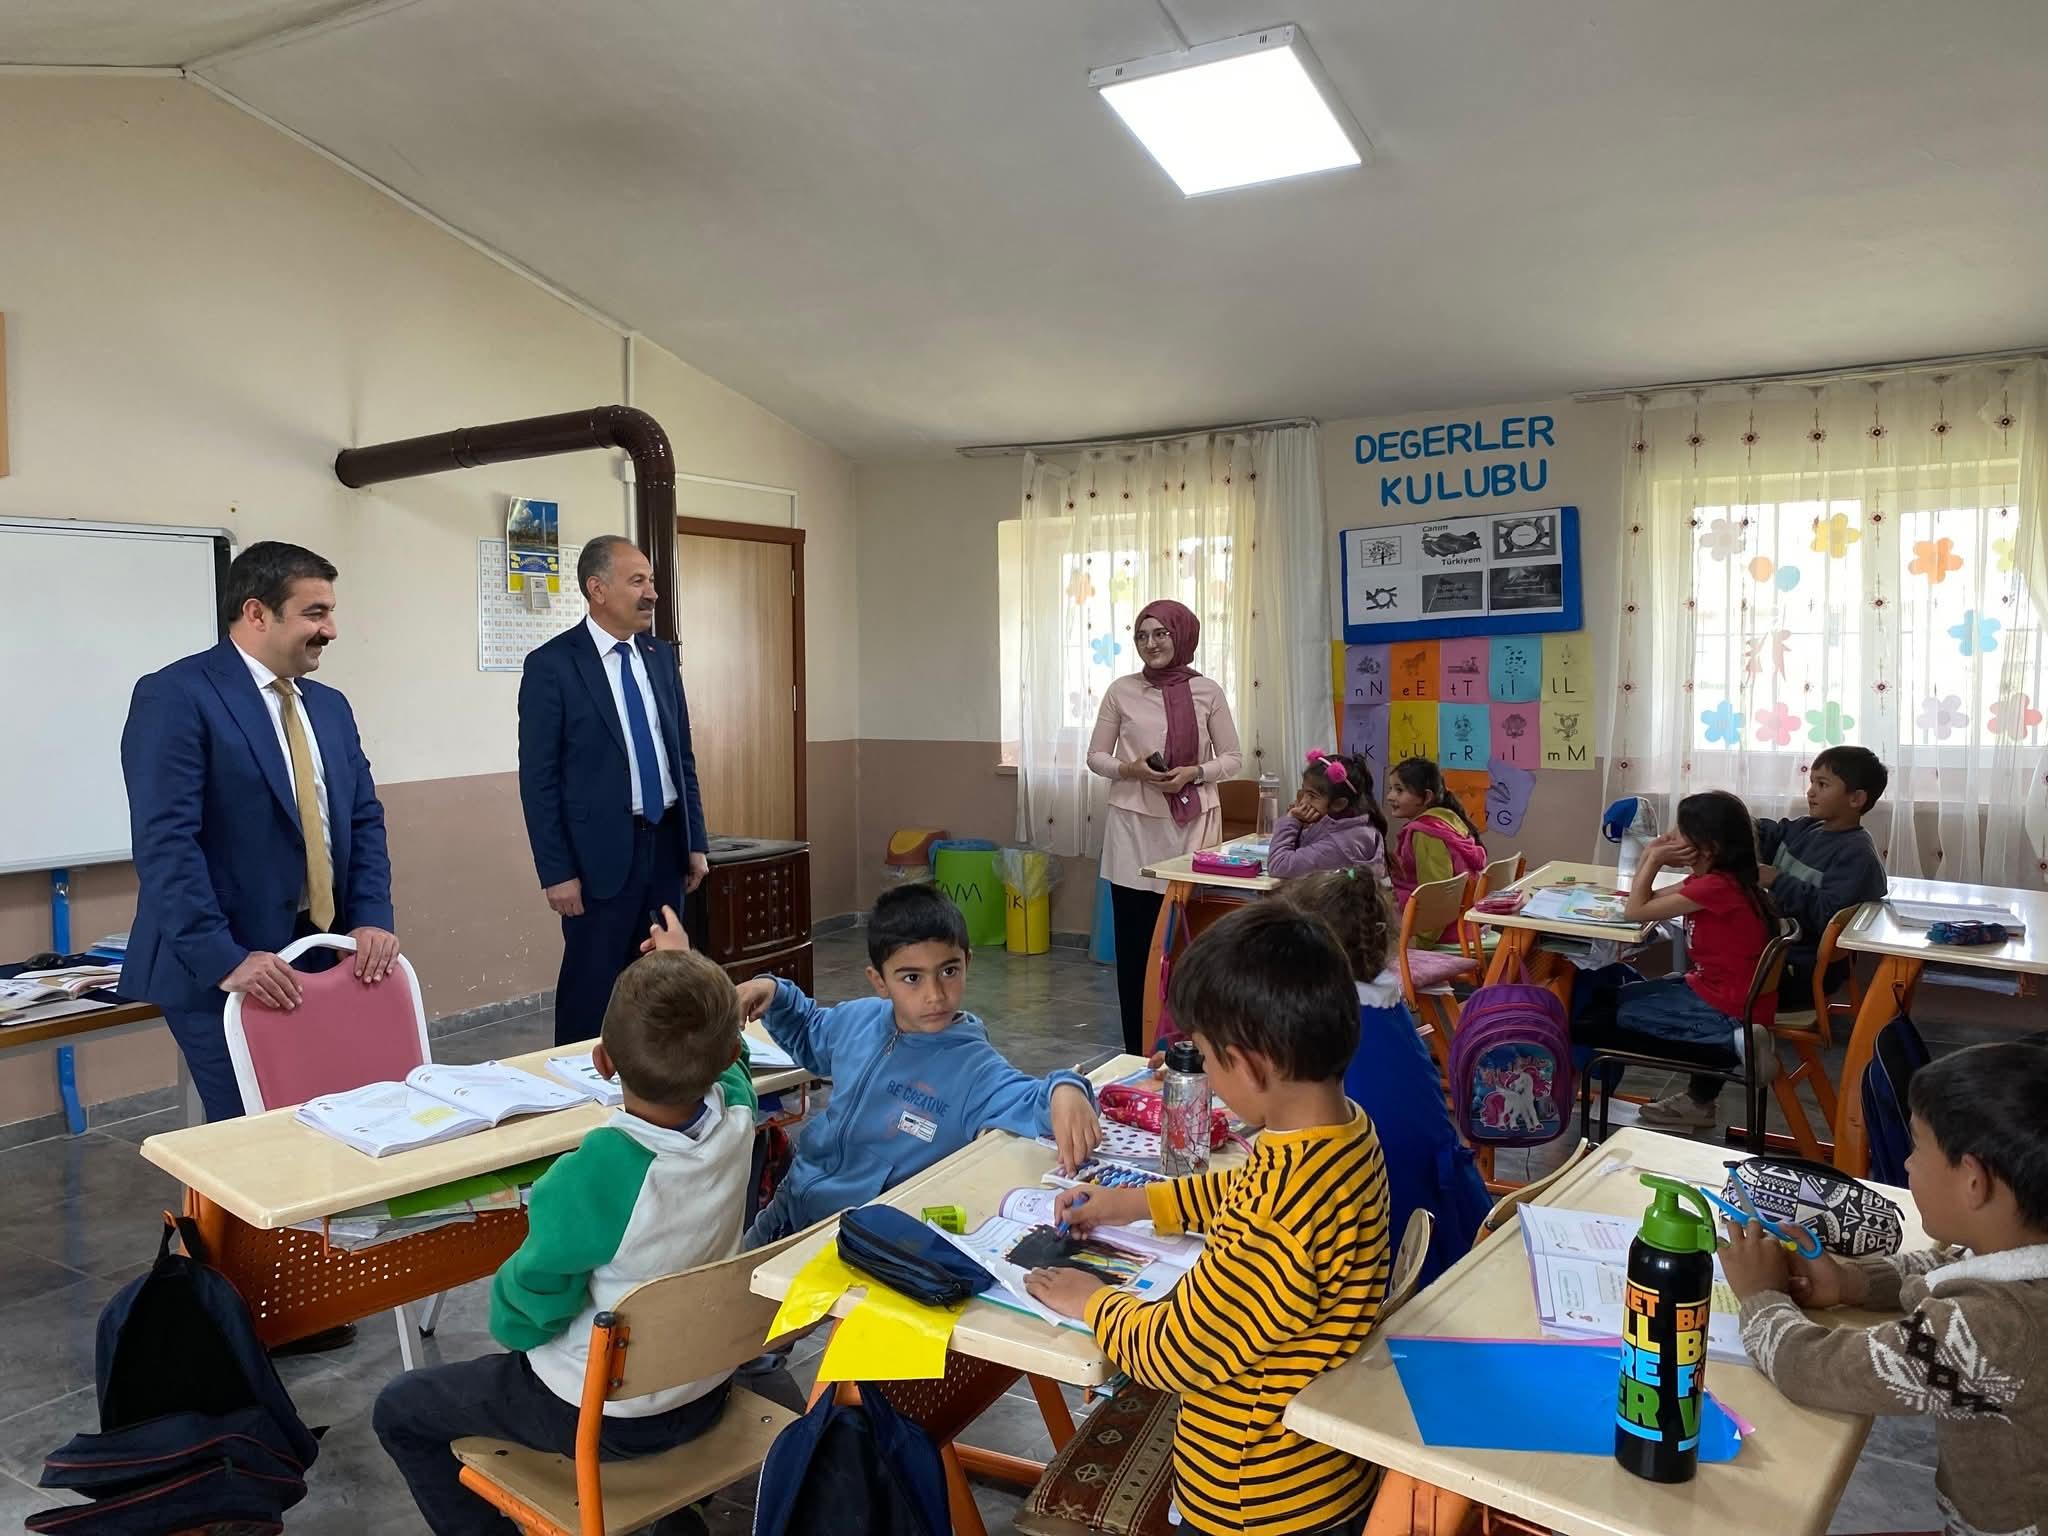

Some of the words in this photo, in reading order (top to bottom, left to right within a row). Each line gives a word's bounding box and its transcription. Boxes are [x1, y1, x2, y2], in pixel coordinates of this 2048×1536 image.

[1355, 416, 1555, 465] DEGERLER
[1381, 458, 1547, 507] KULUBU
[1441, 556, 1481, 566] Türkiyem
[1355, 688, 1364, 696] n
[1370, 680, 1383, 696] N
[1402, 688, 1410, 696] e
[1416, 680, 1425, 696] E
[1450, 683, 1456, 696] t
[1463, 680, 1473, 696] T
[1564, 676, 1576, 694] L
[1365, 744, 1376, 760] K
[1449, 752, 1457, 760] r
[1464, 745, 1474, 760] R
[1547, 752, 1561, 760] m
[1568, 745, 1586, 760] M
[1496, 809, 1513, 826] G
[935, 880, 982, 904] AM
[887, 1079, 904, 1097] BE
[903, 1088, 951, 1118] CREATIVE
[1676, 1330, 1707, 1366] B
